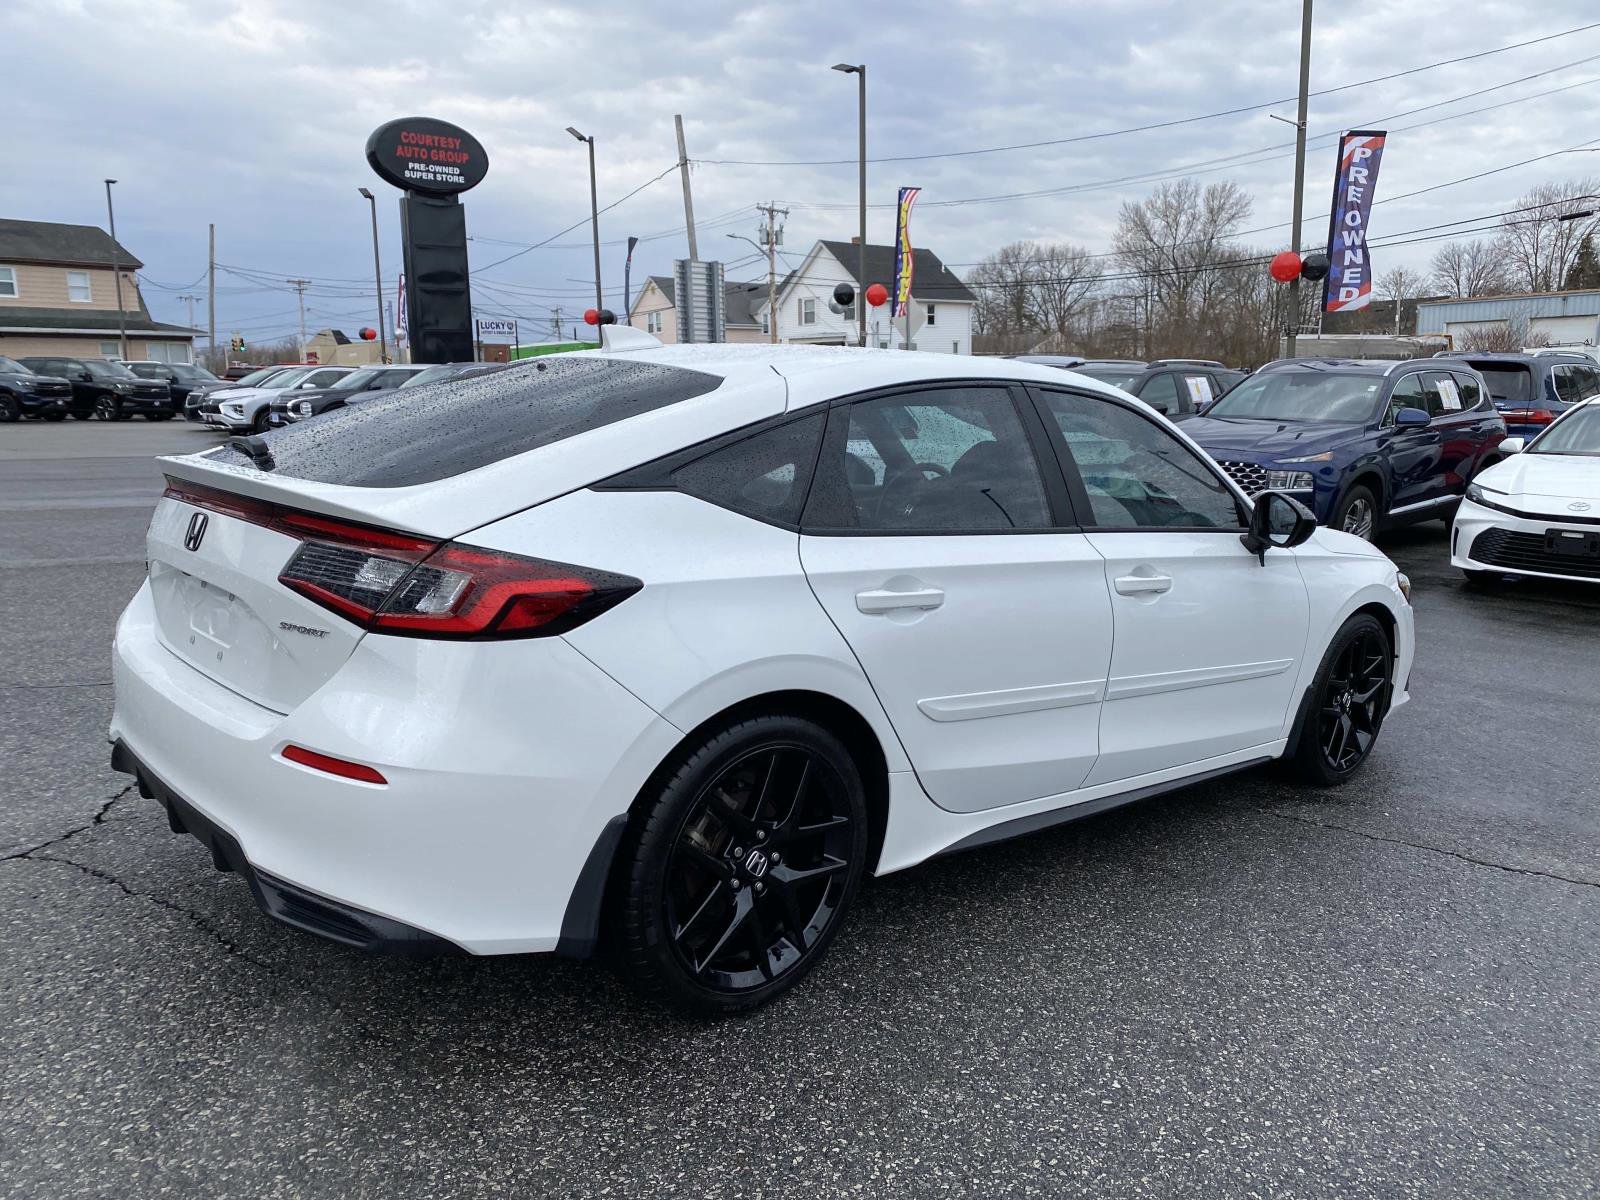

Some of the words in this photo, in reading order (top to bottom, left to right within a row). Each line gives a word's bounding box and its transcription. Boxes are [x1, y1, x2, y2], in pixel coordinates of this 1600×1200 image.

[401, 131, 461, 148] COURTESY
[396, 145, 428, 159] AUTO
[431, 149, 468, 163] GROUP
[408, 162, 460, 174] PRE-OWNED
[405, 170, 434, 179] SUPER
[436, 173, 465, 183] STORE
[480, 321, 506, 329] LUCKY
[279, 621, 330, 638] SPORT
